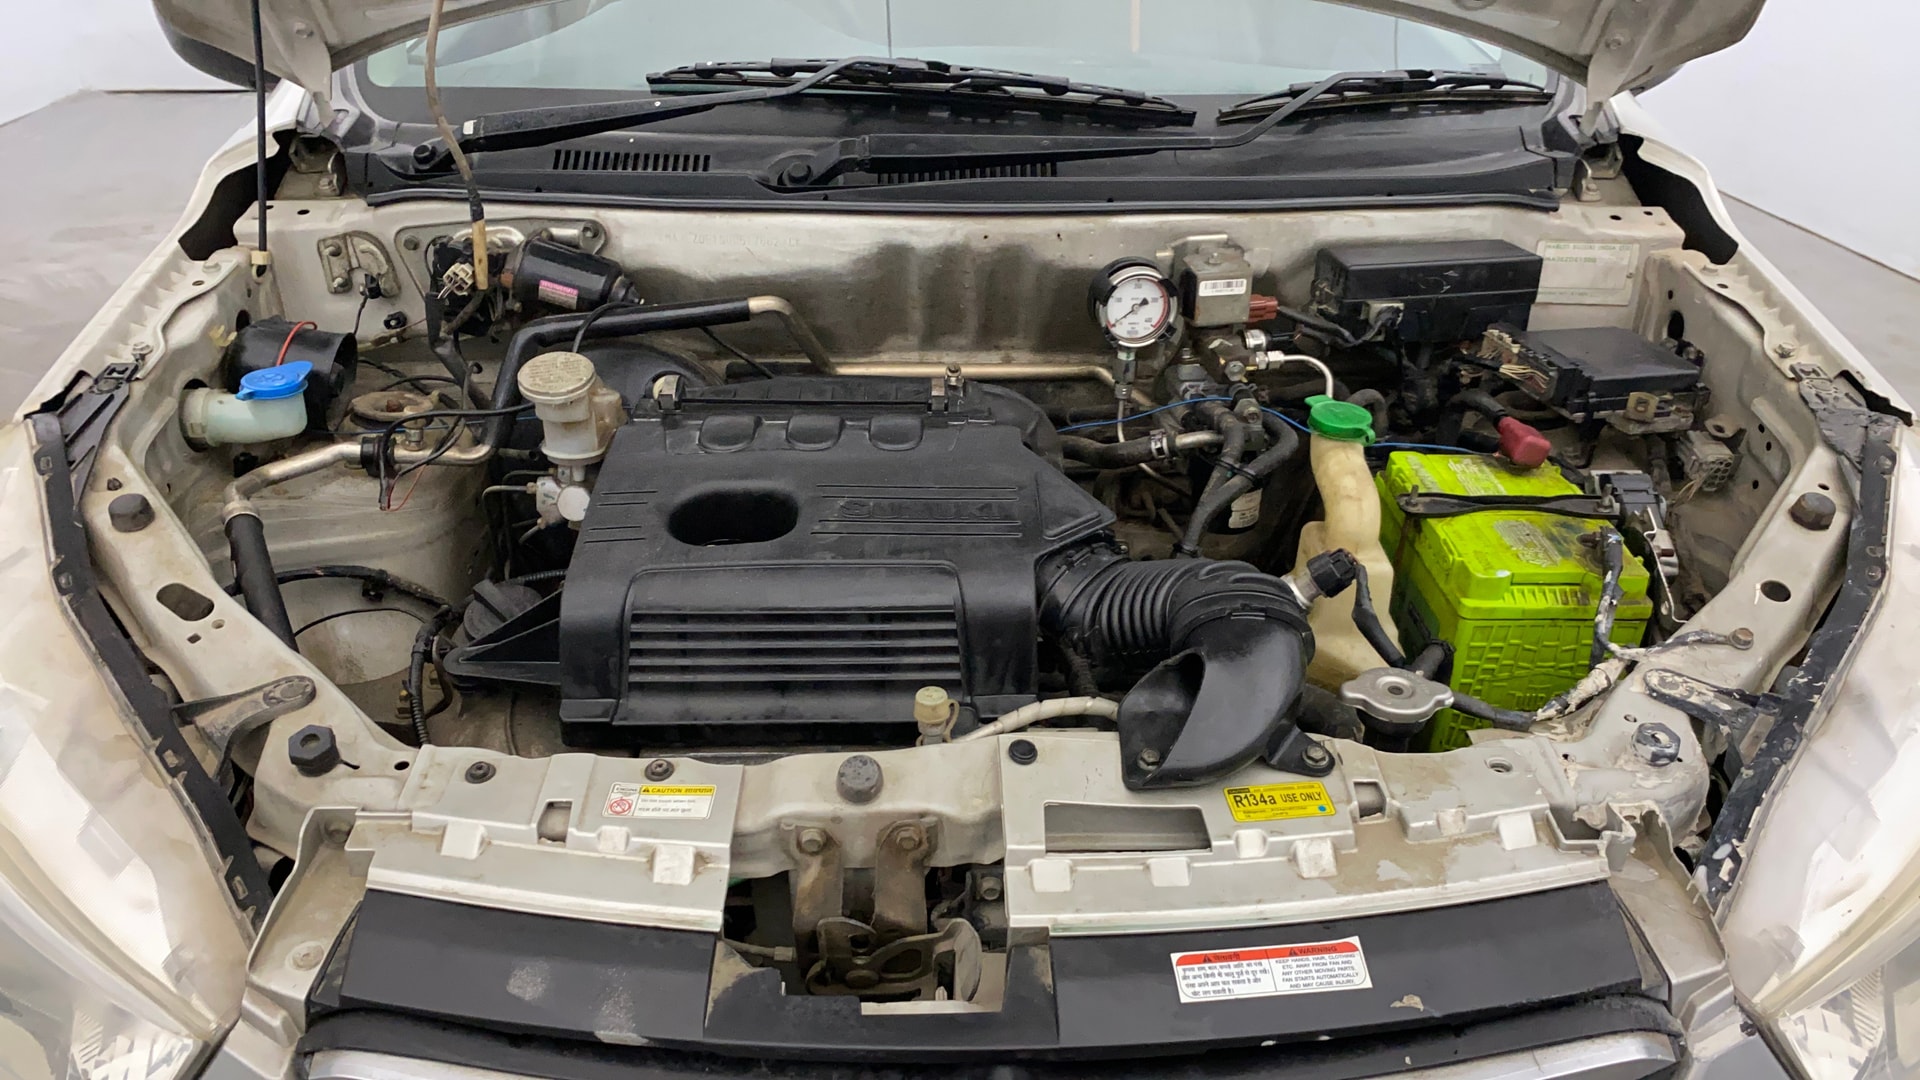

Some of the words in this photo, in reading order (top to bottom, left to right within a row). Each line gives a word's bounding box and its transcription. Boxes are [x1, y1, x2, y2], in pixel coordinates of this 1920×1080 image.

[1233, 793, 1277, 808] R134a
[1280, 793, 1299, 803] USE
[1299, 791, 1322, 802] ONLY
[1299, 946, 1337, 954] WARNING
